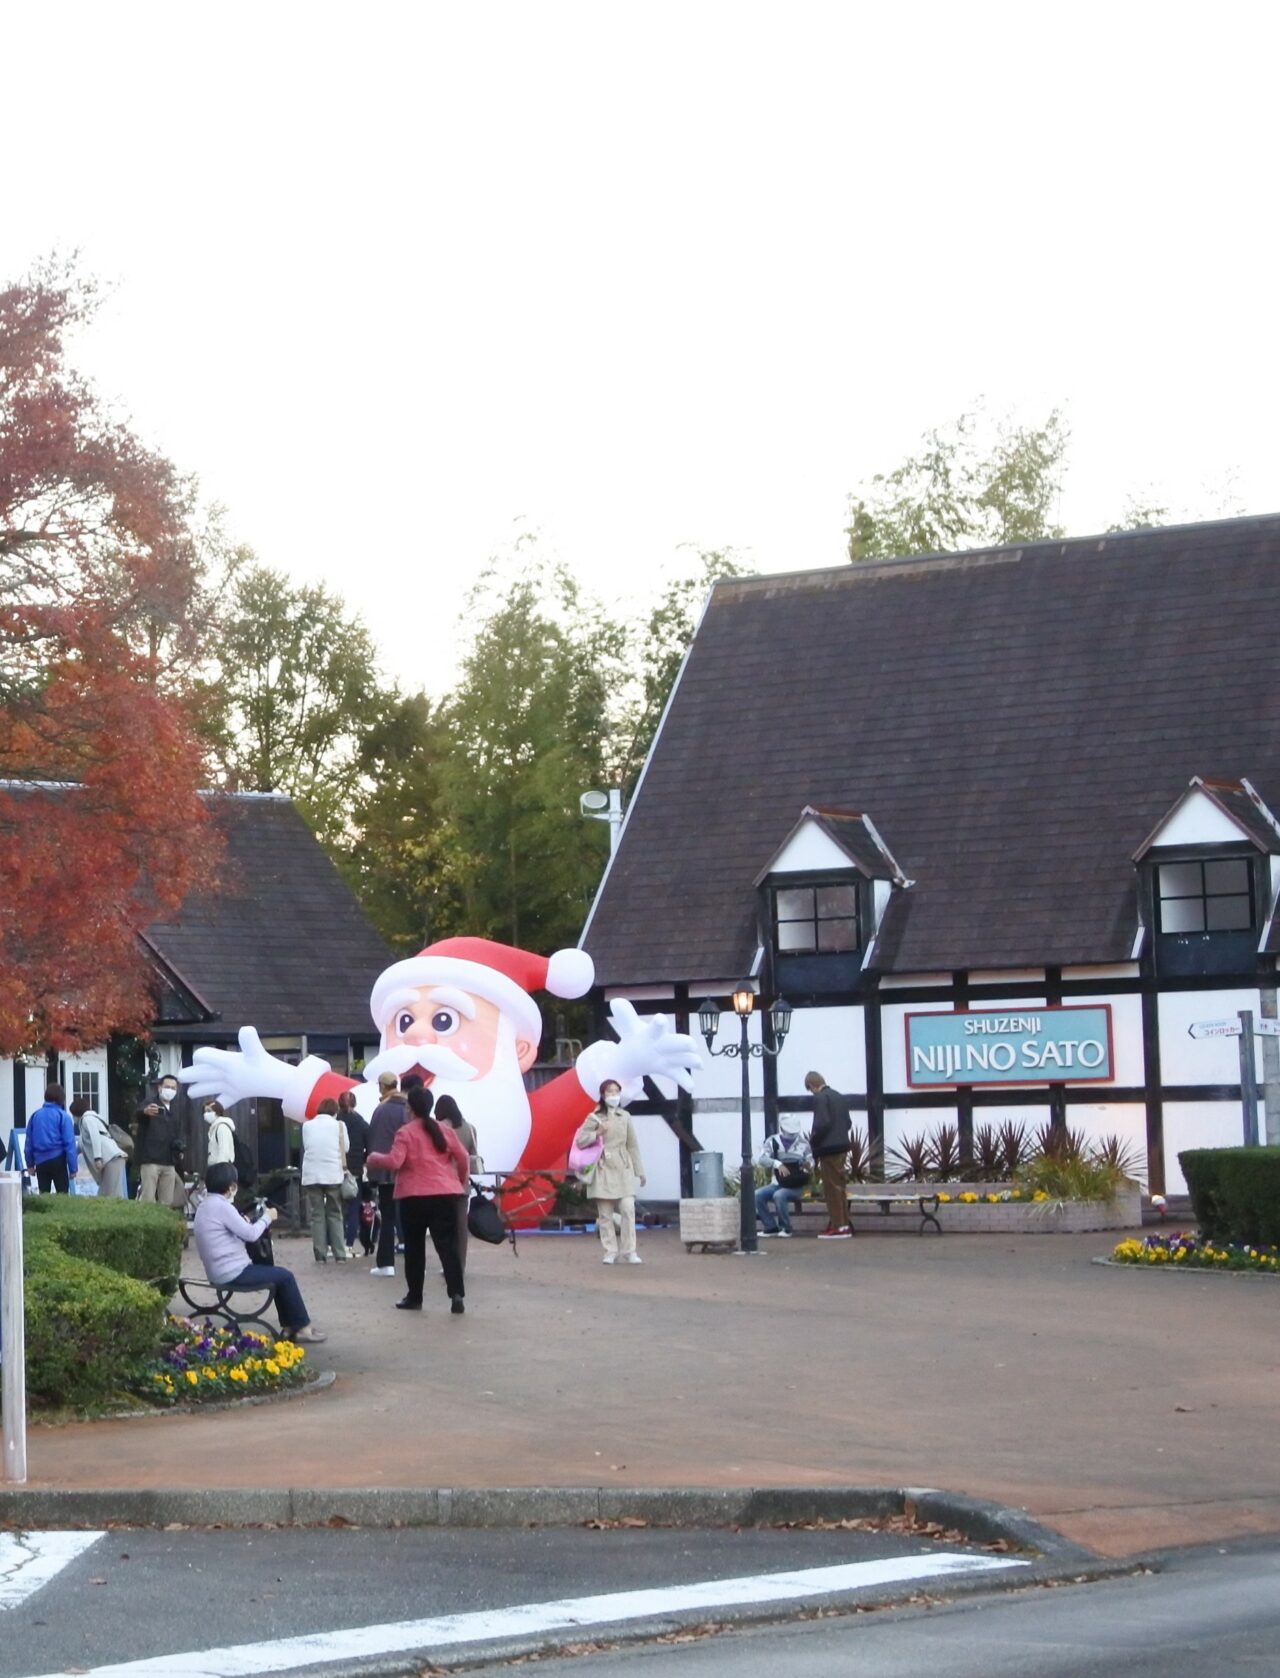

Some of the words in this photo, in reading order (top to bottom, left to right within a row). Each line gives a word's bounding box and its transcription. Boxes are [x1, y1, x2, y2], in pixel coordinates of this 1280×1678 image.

[964, 1017, 1042, 1035] SHUZENJI
[913, 1044, 962, 1079] NIJI
[966, 1042, 1017, 1072] NO
[1021, 1039, 1106, 1070] SATO
